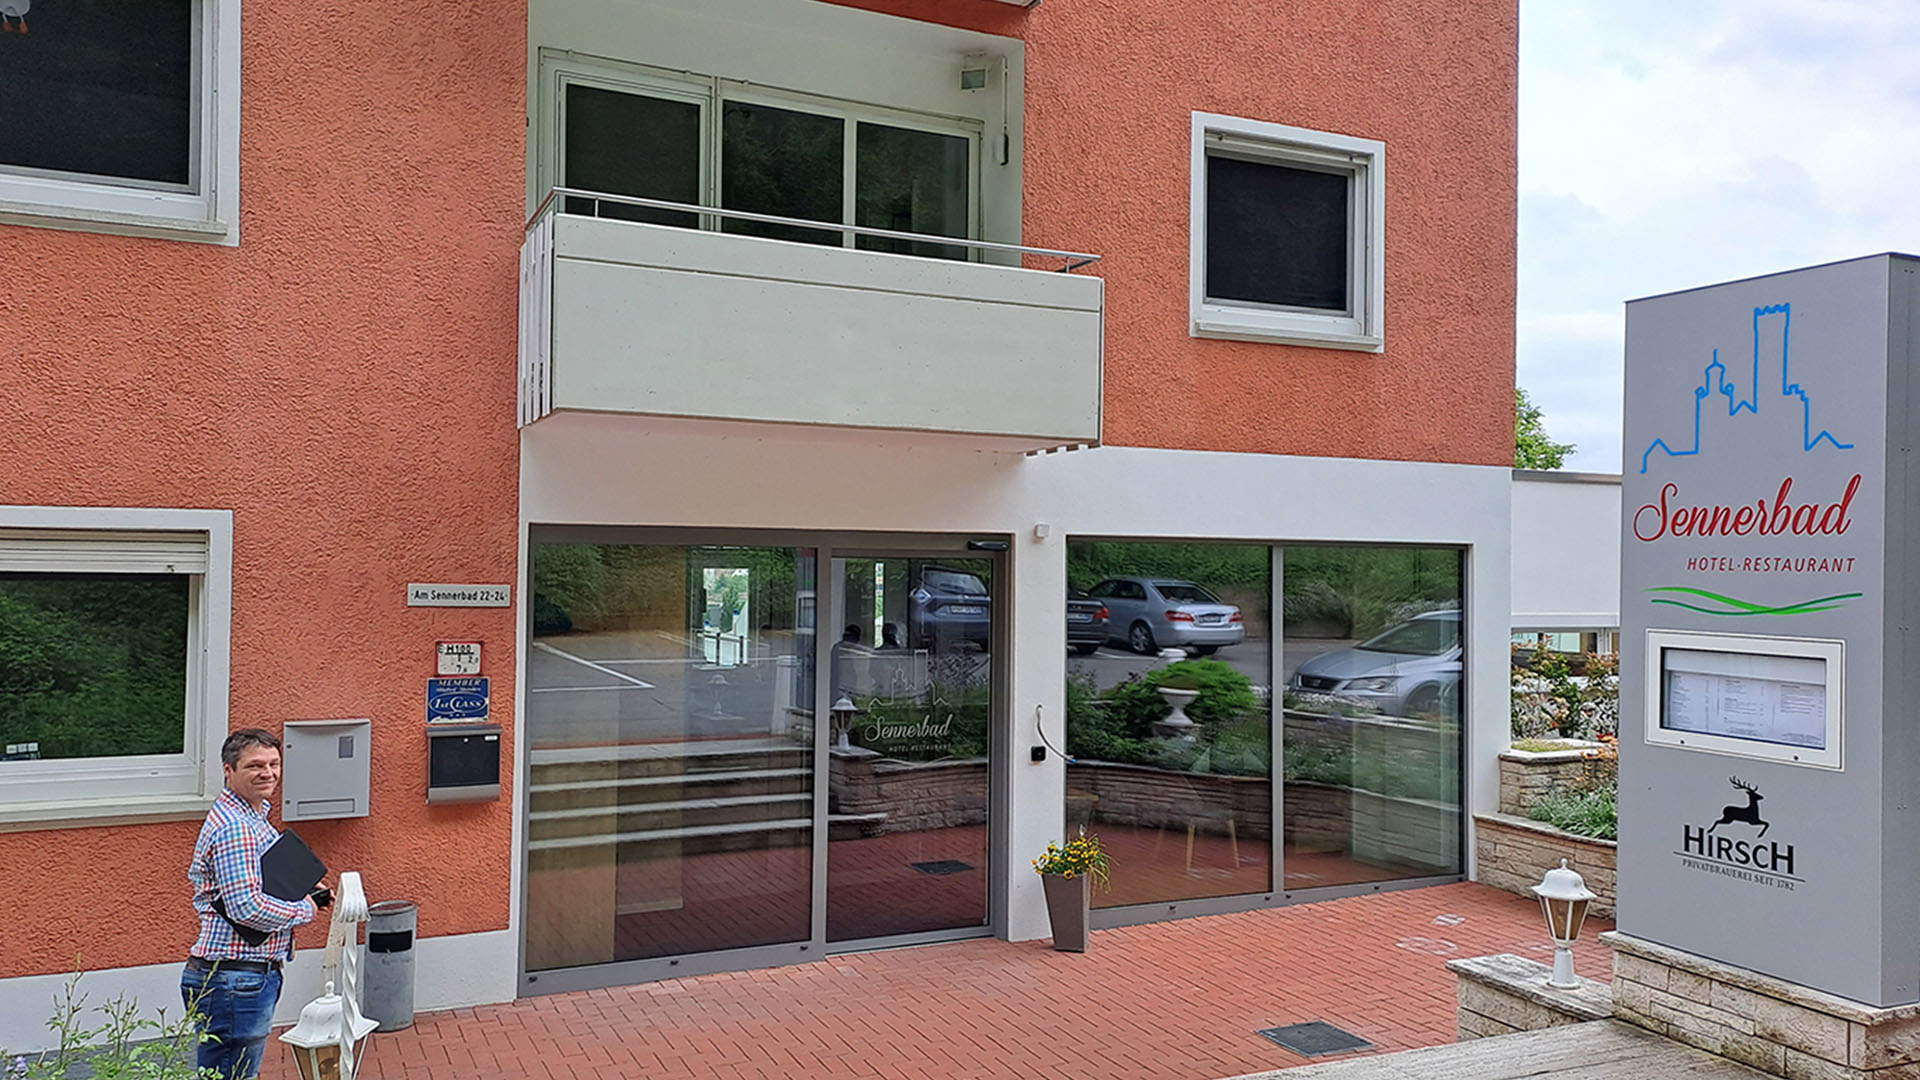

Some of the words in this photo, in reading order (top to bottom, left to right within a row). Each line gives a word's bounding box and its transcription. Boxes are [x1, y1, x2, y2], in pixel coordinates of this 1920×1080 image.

[1633, 473, 1862, 542] Sennerbad
[431, 590, 478, 601] Sennerbad
[864, 713, 953, 742] Sennerbad
[1683, 824, 1794, 874] HIRSCH
[1682, 858, 1752, 882] PRIVATBRAUEREI
[1754, 874, 1774, 886] SEIT
